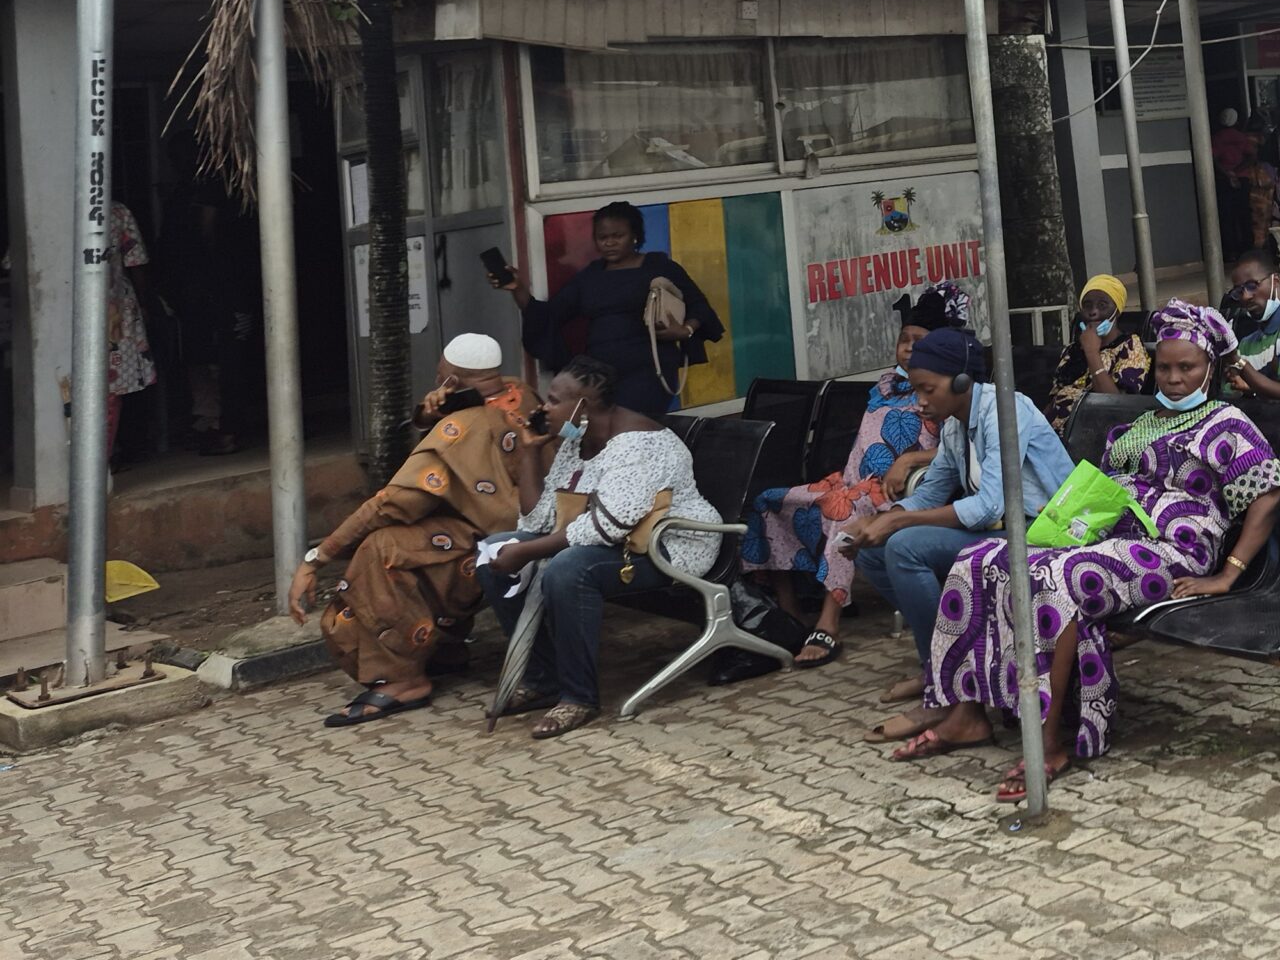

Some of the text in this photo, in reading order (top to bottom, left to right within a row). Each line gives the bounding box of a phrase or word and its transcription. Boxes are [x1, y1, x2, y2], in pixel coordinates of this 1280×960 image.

[91, 58, 105, 137] FCCK
[807, 240, 982, 304] REVENUE UNIT
